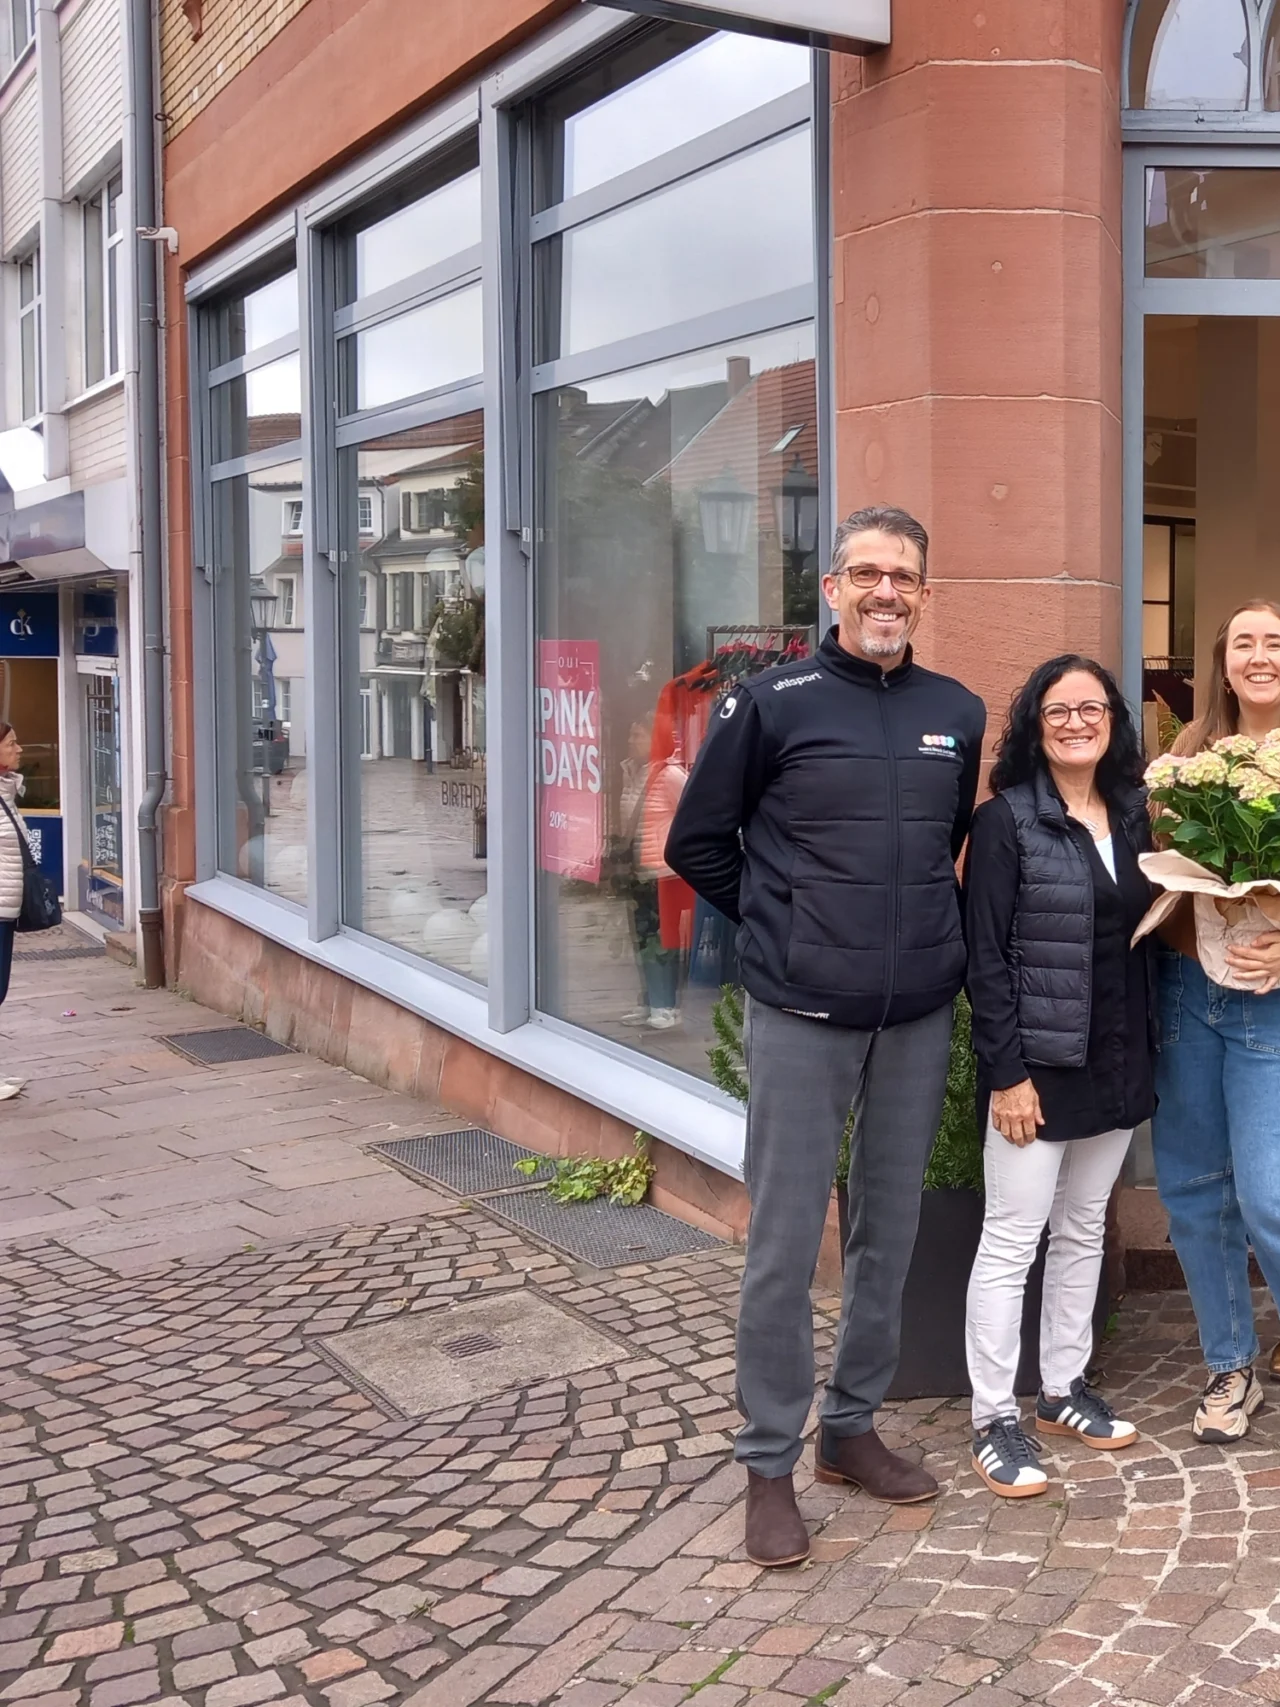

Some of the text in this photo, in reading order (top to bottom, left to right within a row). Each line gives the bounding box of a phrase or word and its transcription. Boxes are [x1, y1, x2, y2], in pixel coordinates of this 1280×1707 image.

[772, 672, 823, 691] uhlsport
[540, 687, 595, 739] PINK
[541, 739, 601, 794] DAYS
[441, 780, 486, 810] BIRTHDA
